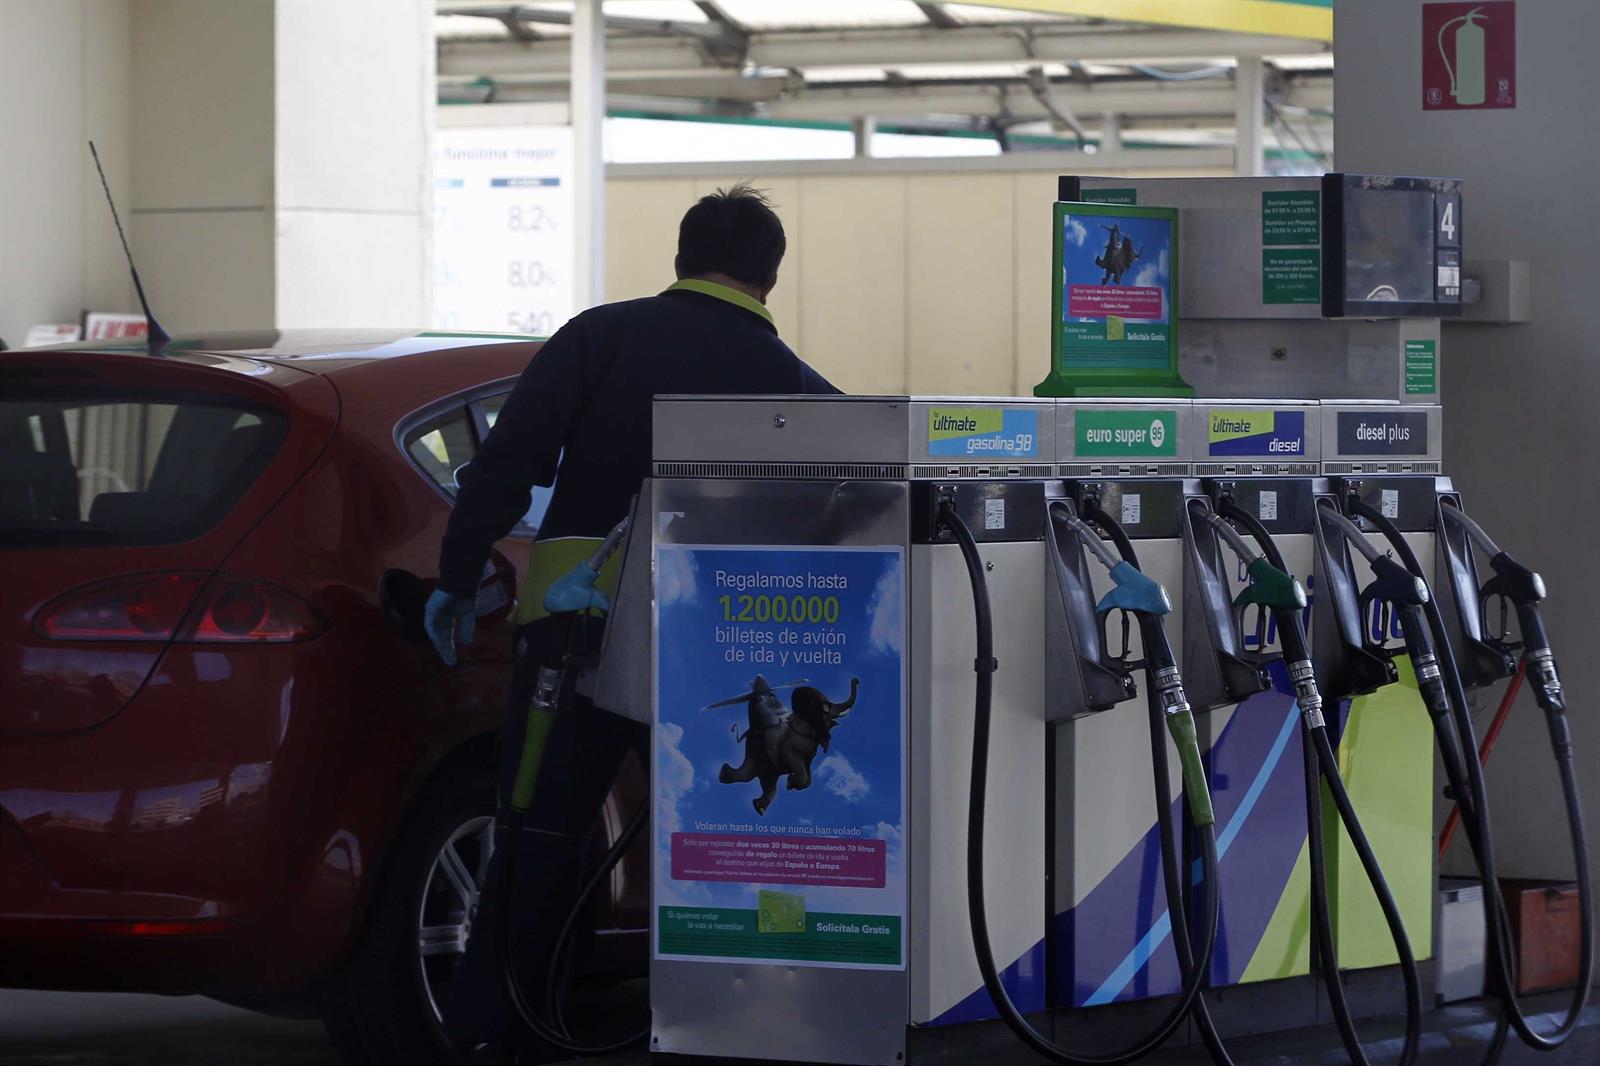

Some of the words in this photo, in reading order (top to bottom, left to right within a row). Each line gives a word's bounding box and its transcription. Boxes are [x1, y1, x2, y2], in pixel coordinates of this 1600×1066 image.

[1441, 202, 1455, 240] 4
[933, 415, 976, 431] ultimate
[1213, 418, 1251, 433] ultimate
[1087, 428, 1112, 443] euro
[1115, 429, 1147, 447] super
[1151, 426, 1163, 441] 95
[1356, 422, 1386, 441] diesel
[1388, 422, 1410, 445] plus
[1269, 437, 1300, 452] diesel
[715, 570, 804, 591] Regalamos
[807, 572, 848, 589] hasta
[719, 594, 840, 624] 1.200.000
[715, 626, 774, 644] billetes
[778, 628, 798, 645] de
[802, 628, 846, 645] avión
[724, 646, 745, 663] de
[750, 646, 774, 663] ida
[779, 651, 789, 667] y
[793, 648, 842, 665] vuelta
[730, 824, 753, 833] hasta
[755, 824, 769, 833] los
[770, 827, 786, 835] que
[815, 826, 831, 836] han
[833, 827, 862, 837] volado
[736, 841, 749, 849] dos
[771, 842, 780, 850] 30
[781, 843, 800, 851] litros
[805, 844, 846, 853] acumulando
[857, 846, 876, 854] litros
[745, 850, 755, 858] de
[756, 851, 778, 860] regalo
[784, 861, 809, 870] España
[815, 862, 841, 872] Europa
[667, 910, 674, 920] Si
[675, 912, 701, 922] quieres
[701, 912, 720, 921] volar
[687, 921, 694, 929] la
[694, 922, 707, 930] vas
[713, 923, 745, 931] necesitar
[862, 924, 891, 935] Gratis
